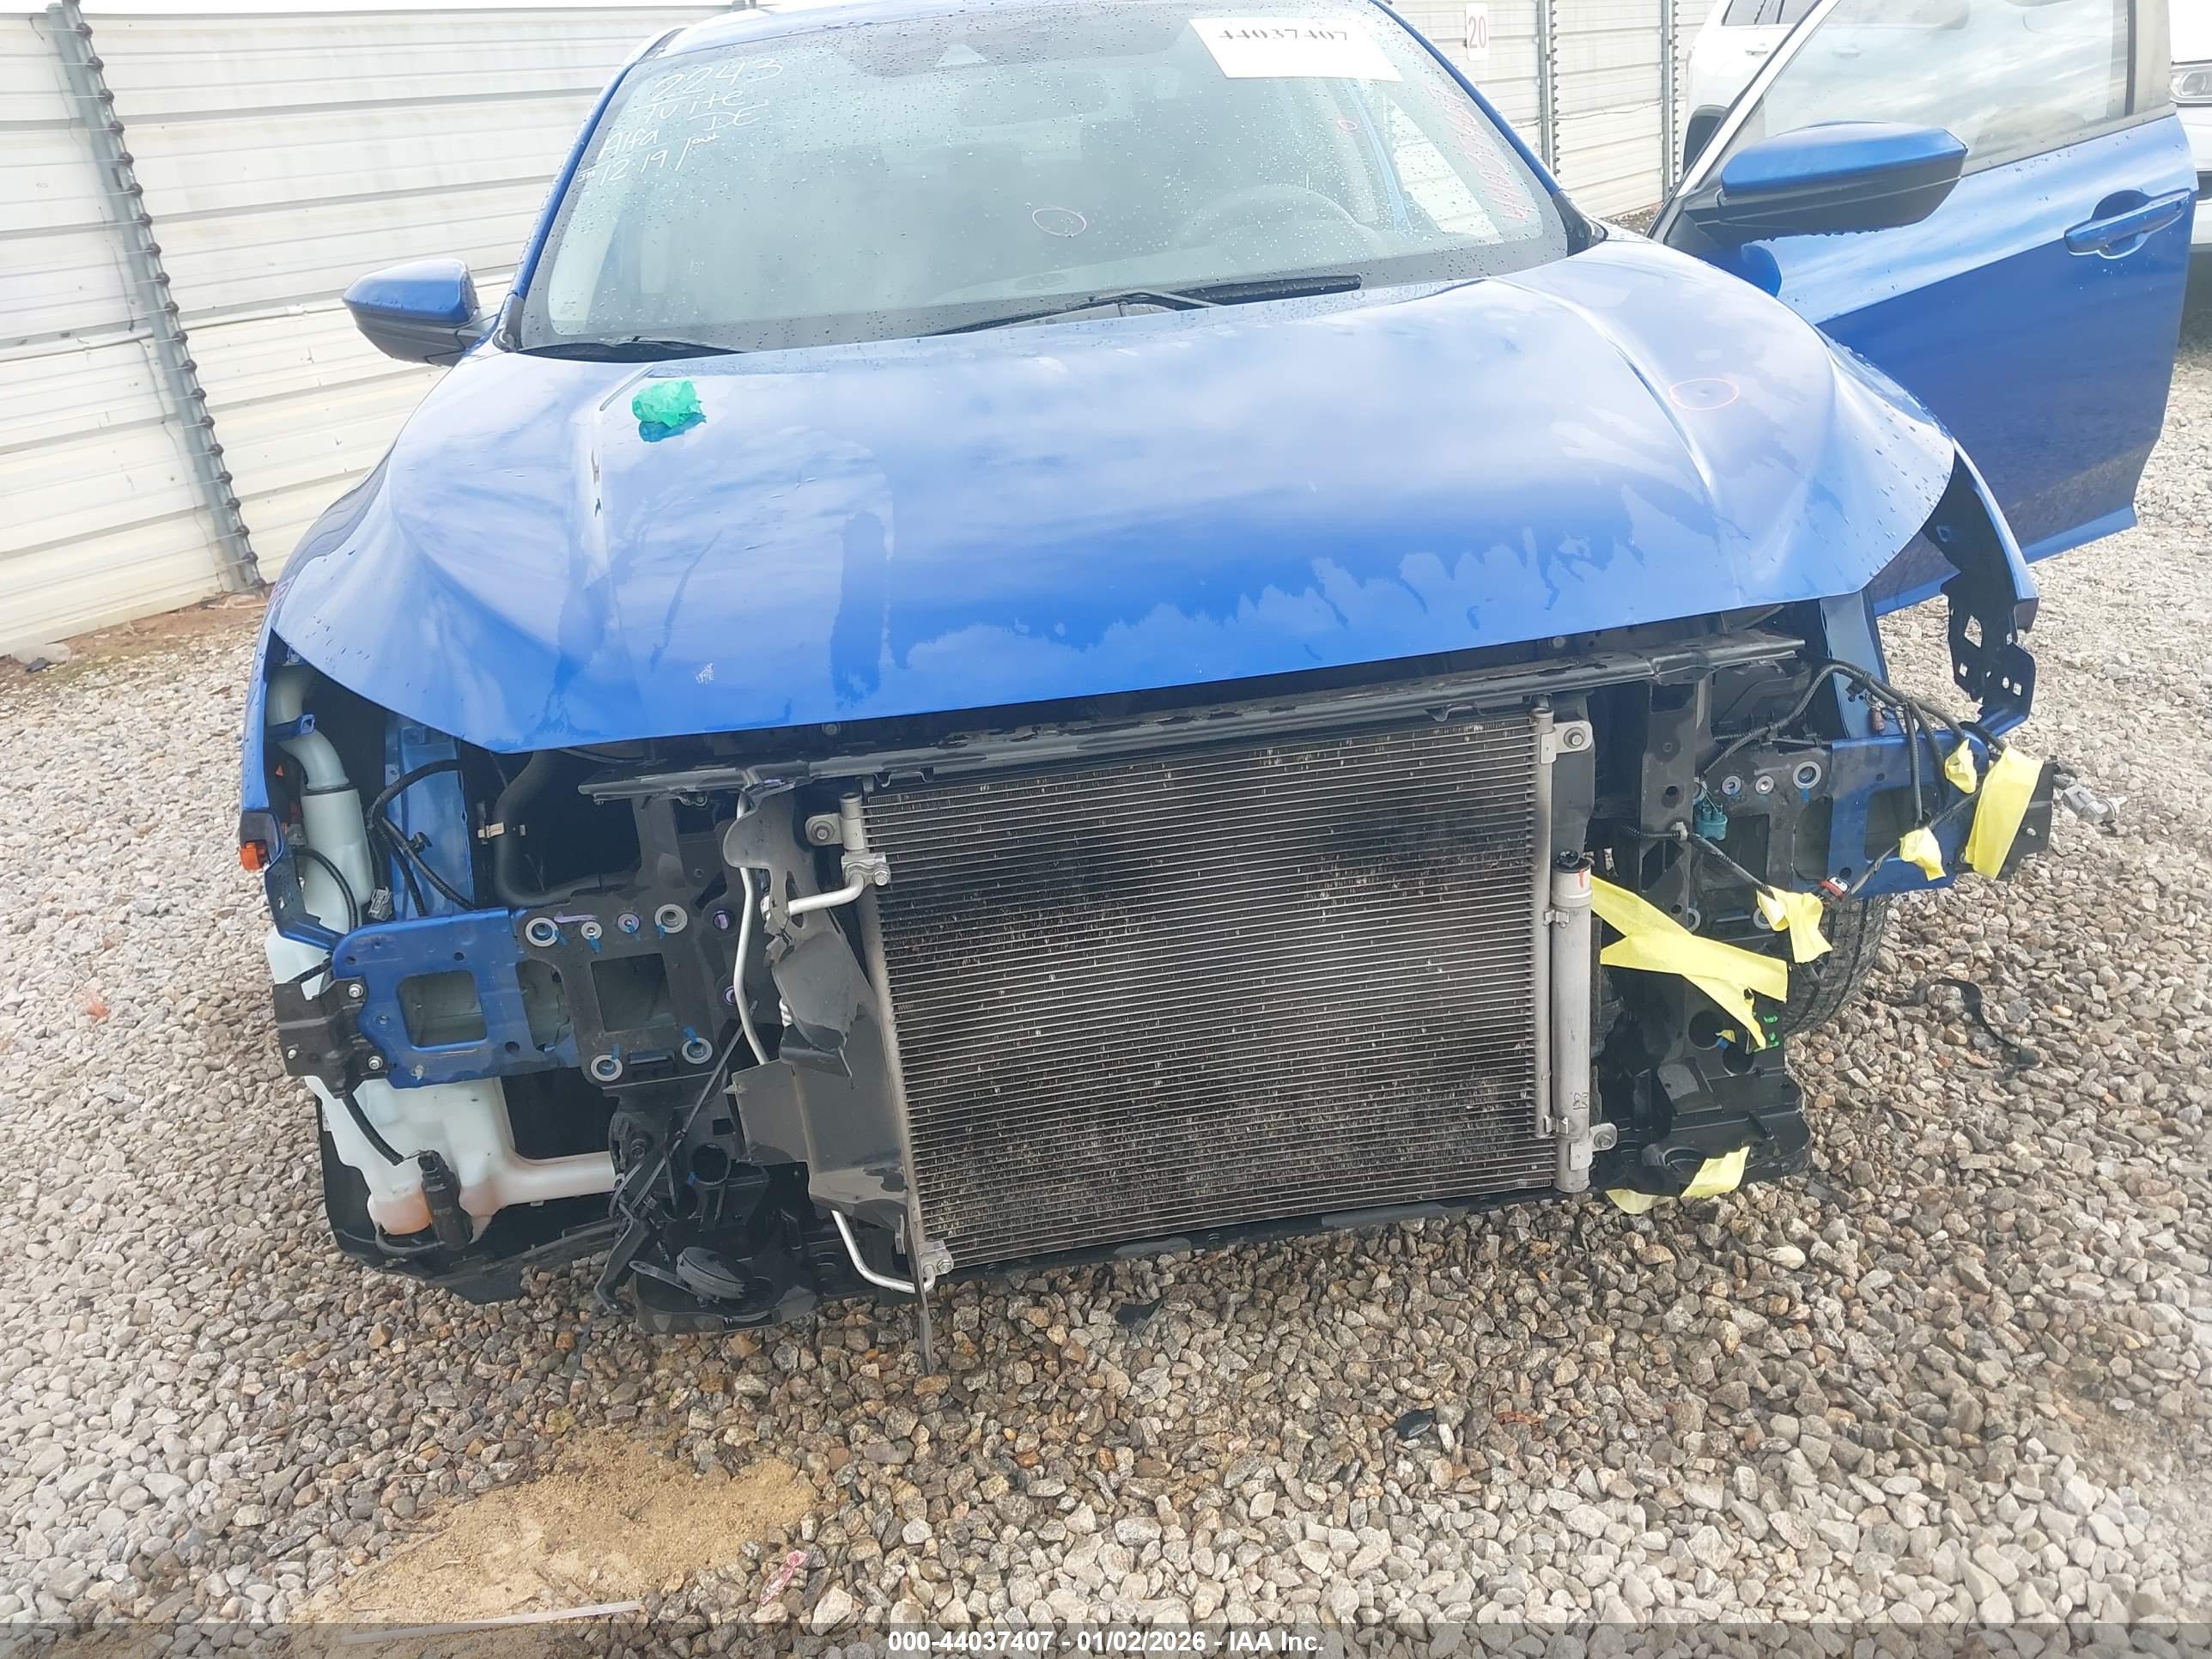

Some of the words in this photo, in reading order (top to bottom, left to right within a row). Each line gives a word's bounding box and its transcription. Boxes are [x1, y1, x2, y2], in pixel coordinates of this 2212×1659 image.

[1468, 15, 1486, 49] 20
[652, 58, 783, 102] 2243
[597, 129, 659, 161] Alfa
